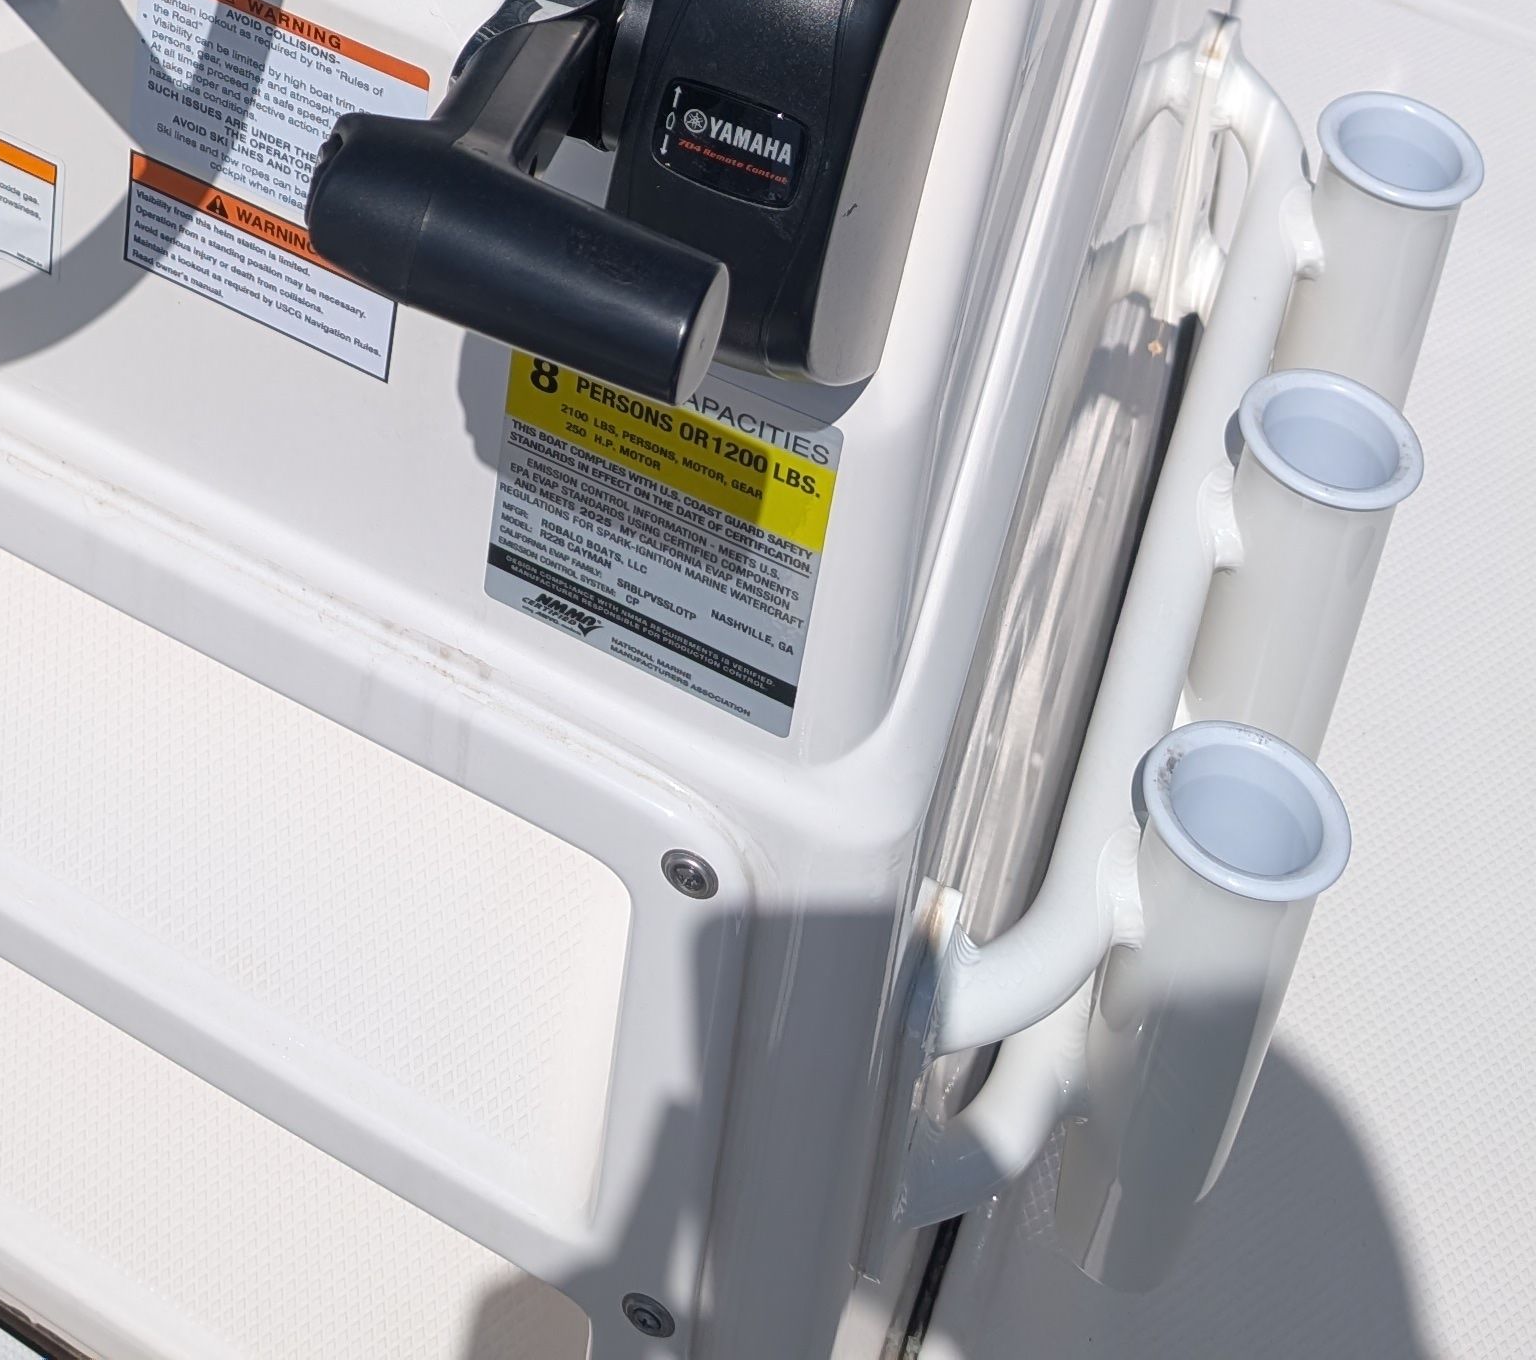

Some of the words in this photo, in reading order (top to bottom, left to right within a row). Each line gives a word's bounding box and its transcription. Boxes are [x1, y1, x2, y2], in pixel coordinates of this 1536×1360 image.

[153, 1, 169, 17] the
[172, 9, 203, 32] Road"
[226, 8, 261, 32] AVOID
[199, 9, 236, 33] lookout
[239, 28, 251, 40] as
[253, 32, 296, 62] required
[299, 53, 313, 69] by
[315, 60, 332, 76] the
[335, 67, 369, 92] "Rules
[372, 84, 383, 98] of
[147, 79, 178, 102] SUCH
[181, 94, 221, 121] ISSUES
[225, 114, 247, 133] ARE
[251, 126, 290, 152] UNDER
[709, 116, 792, 166] YAMAHA
[678, 138, 701, 153] 704
[703, 148, 745, 168] Remote
[746, 164, 788, 185] Control
[275, 300, 302, 320] USCG
[304, 313, 351, 343] Navigation
[353, 336, 382, 357] Rules.
[529, 355, 560, 397] 8
[575, 375, 674, 434] PERSONS
[678, 420, 709, 449] OR
[710, 434, 769, 475] 1200
[772, 461, 823, 499] LBS.
[560, 403, 588, 423] 2100
[621, 430, 679, 464] PERSONS,
[681, 456, 727, 486] MOTOR,
[730, 477, 763, 500] GEAR
[565, 421, 586, 438] 250
[593, 434, 616, 451] H.P.
[618, 444, 661, 471] MOTOR
[683, 388, 831, 468] APACITIES
[511, 419, 536, 438] THIS
[538, 431, 566, 451] BOAT
[571, 445, 627, 478] COMPLIES
[628, 471, 657, 492] WITH
[658, 484, 682, 503] U.S.
[682, 495, 721, 520] COAST
[723, 513, 765, 540] GUARD
[766, 533, 812, 561] SAFETY
[540, 518, 583, 546] ROBALO
[585, 538, 625, 565] BOATS,
[627, 557, 647, 575] LLC
[567, 541, 611, 569] CAYMAN
[710, 609, 775, 647] NASHVILLE,
[777, 640, 794, 656] GA
